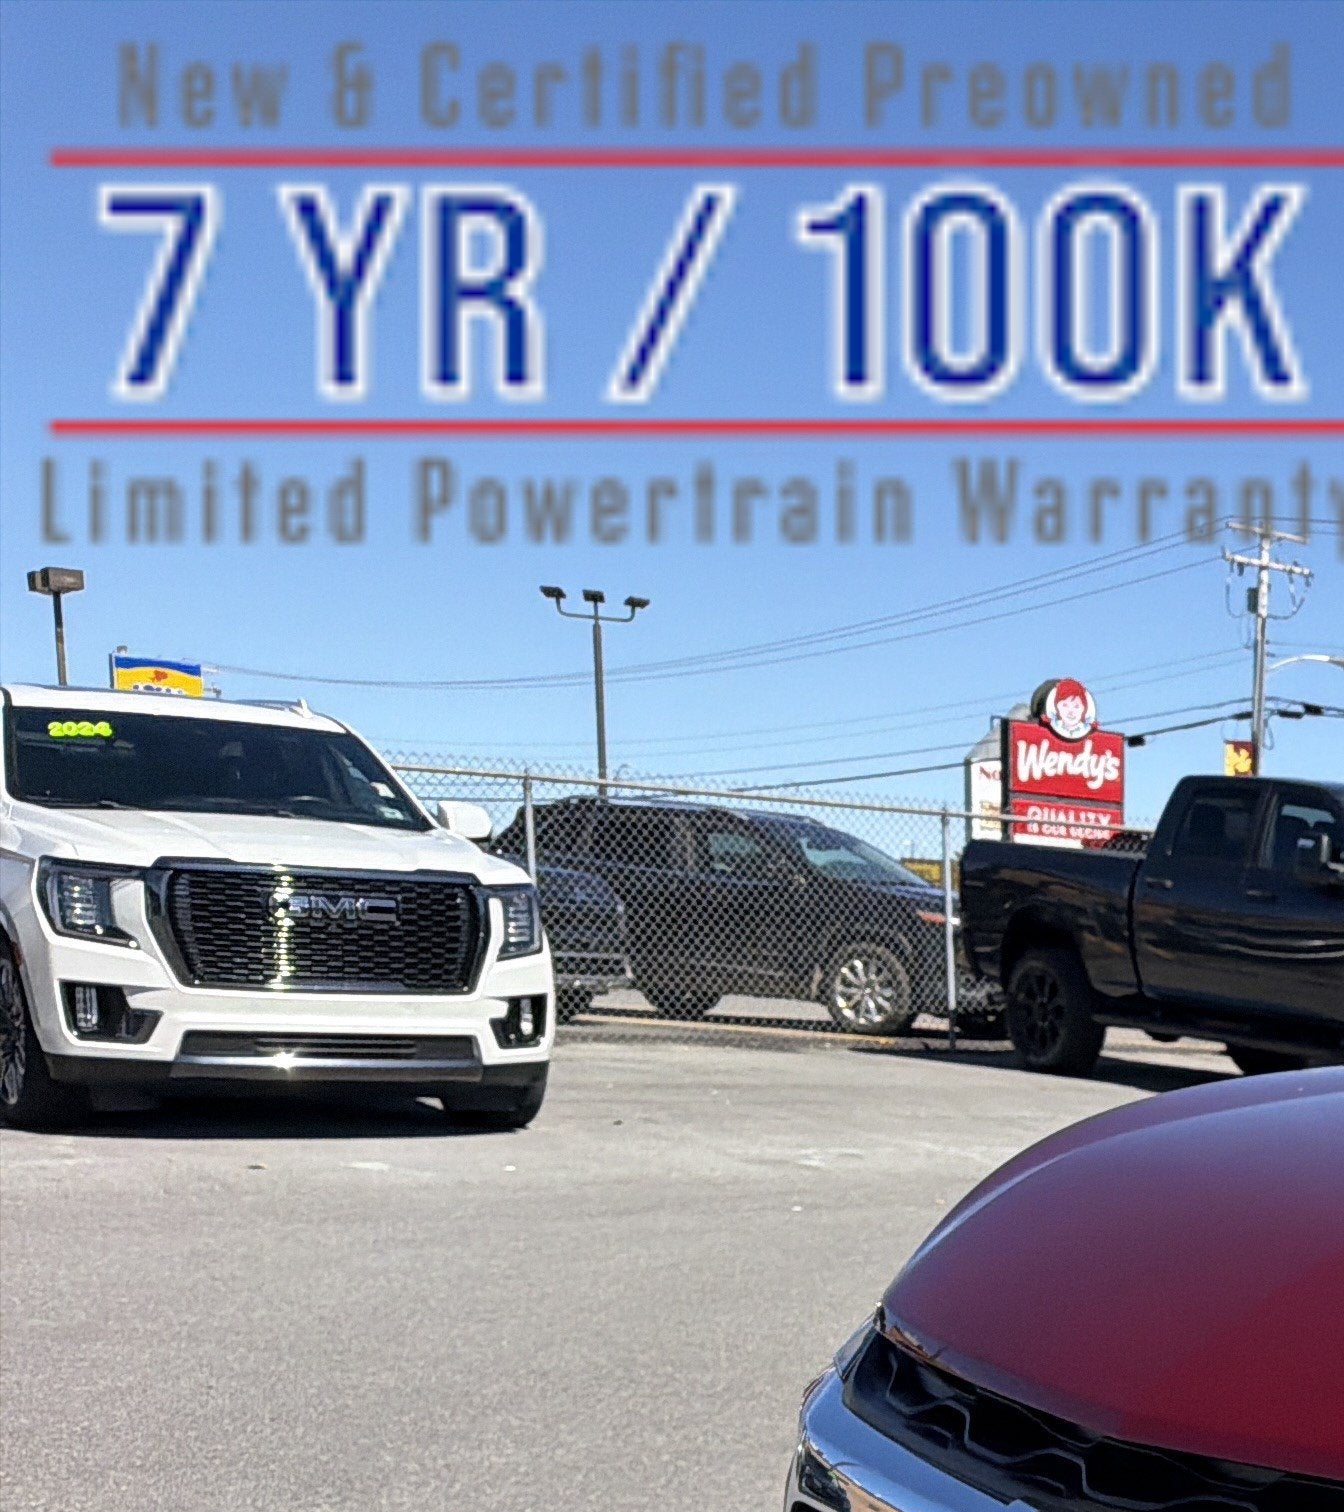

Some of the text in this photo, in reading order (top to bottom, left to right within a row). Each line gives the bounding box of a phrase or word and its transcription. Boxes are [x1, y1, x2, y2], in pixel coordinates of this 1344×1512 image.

[47, 721, 113, 737] 2024
[1016, 739, 1121, 790] Wendy's
[1027, 805, 1111, 827] QUALITY
[268, 894, 398, 922] GMC
